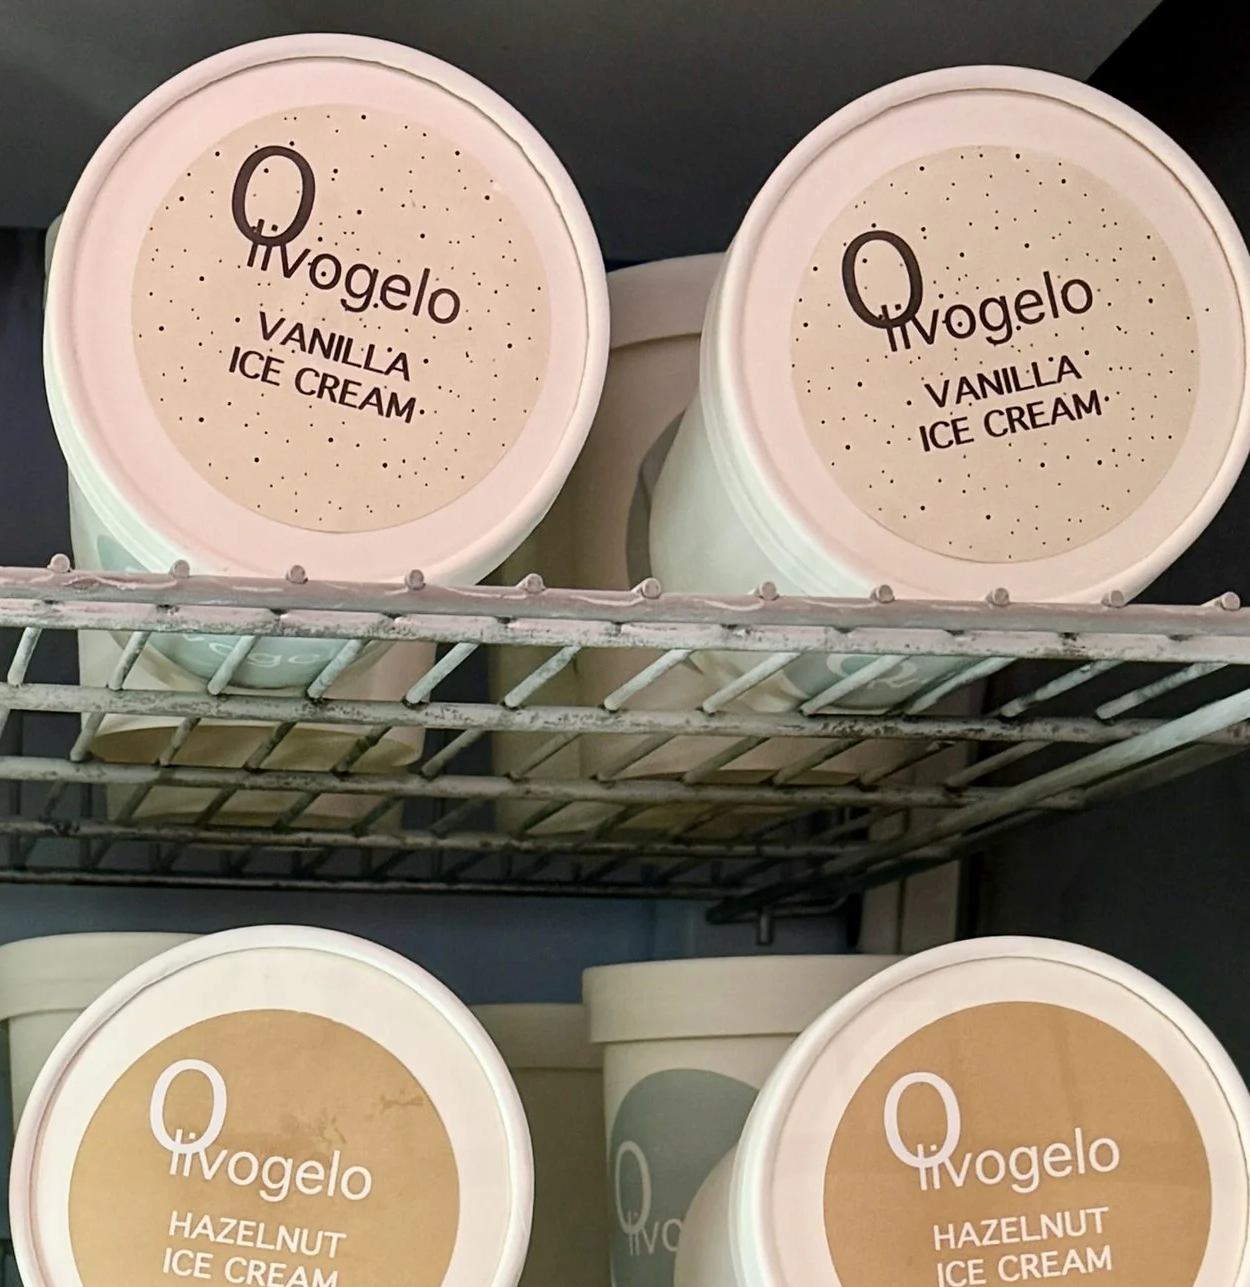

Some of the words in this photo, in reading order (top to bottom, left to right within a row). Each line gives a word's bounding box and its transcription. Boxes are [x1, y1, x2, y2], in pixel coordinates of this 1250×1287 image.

[257, 311, 414, 381] VANILLA
[228, 347, 282, 387] ICE
[292, 357, 418, 423] CREAM
[924, 351, 1084, 408] VANILLA
[918, 418, 975, 452] ICE
[981, 392, 1104, 440] CREAM
[168, 1210, 347, 1258] HAZELNUT
[933, 1207, 1110, 1251] HAZELNUT
[162, 1248, 214, 1282] ICE
[995, 1245, 1113, 1283] CREAM
